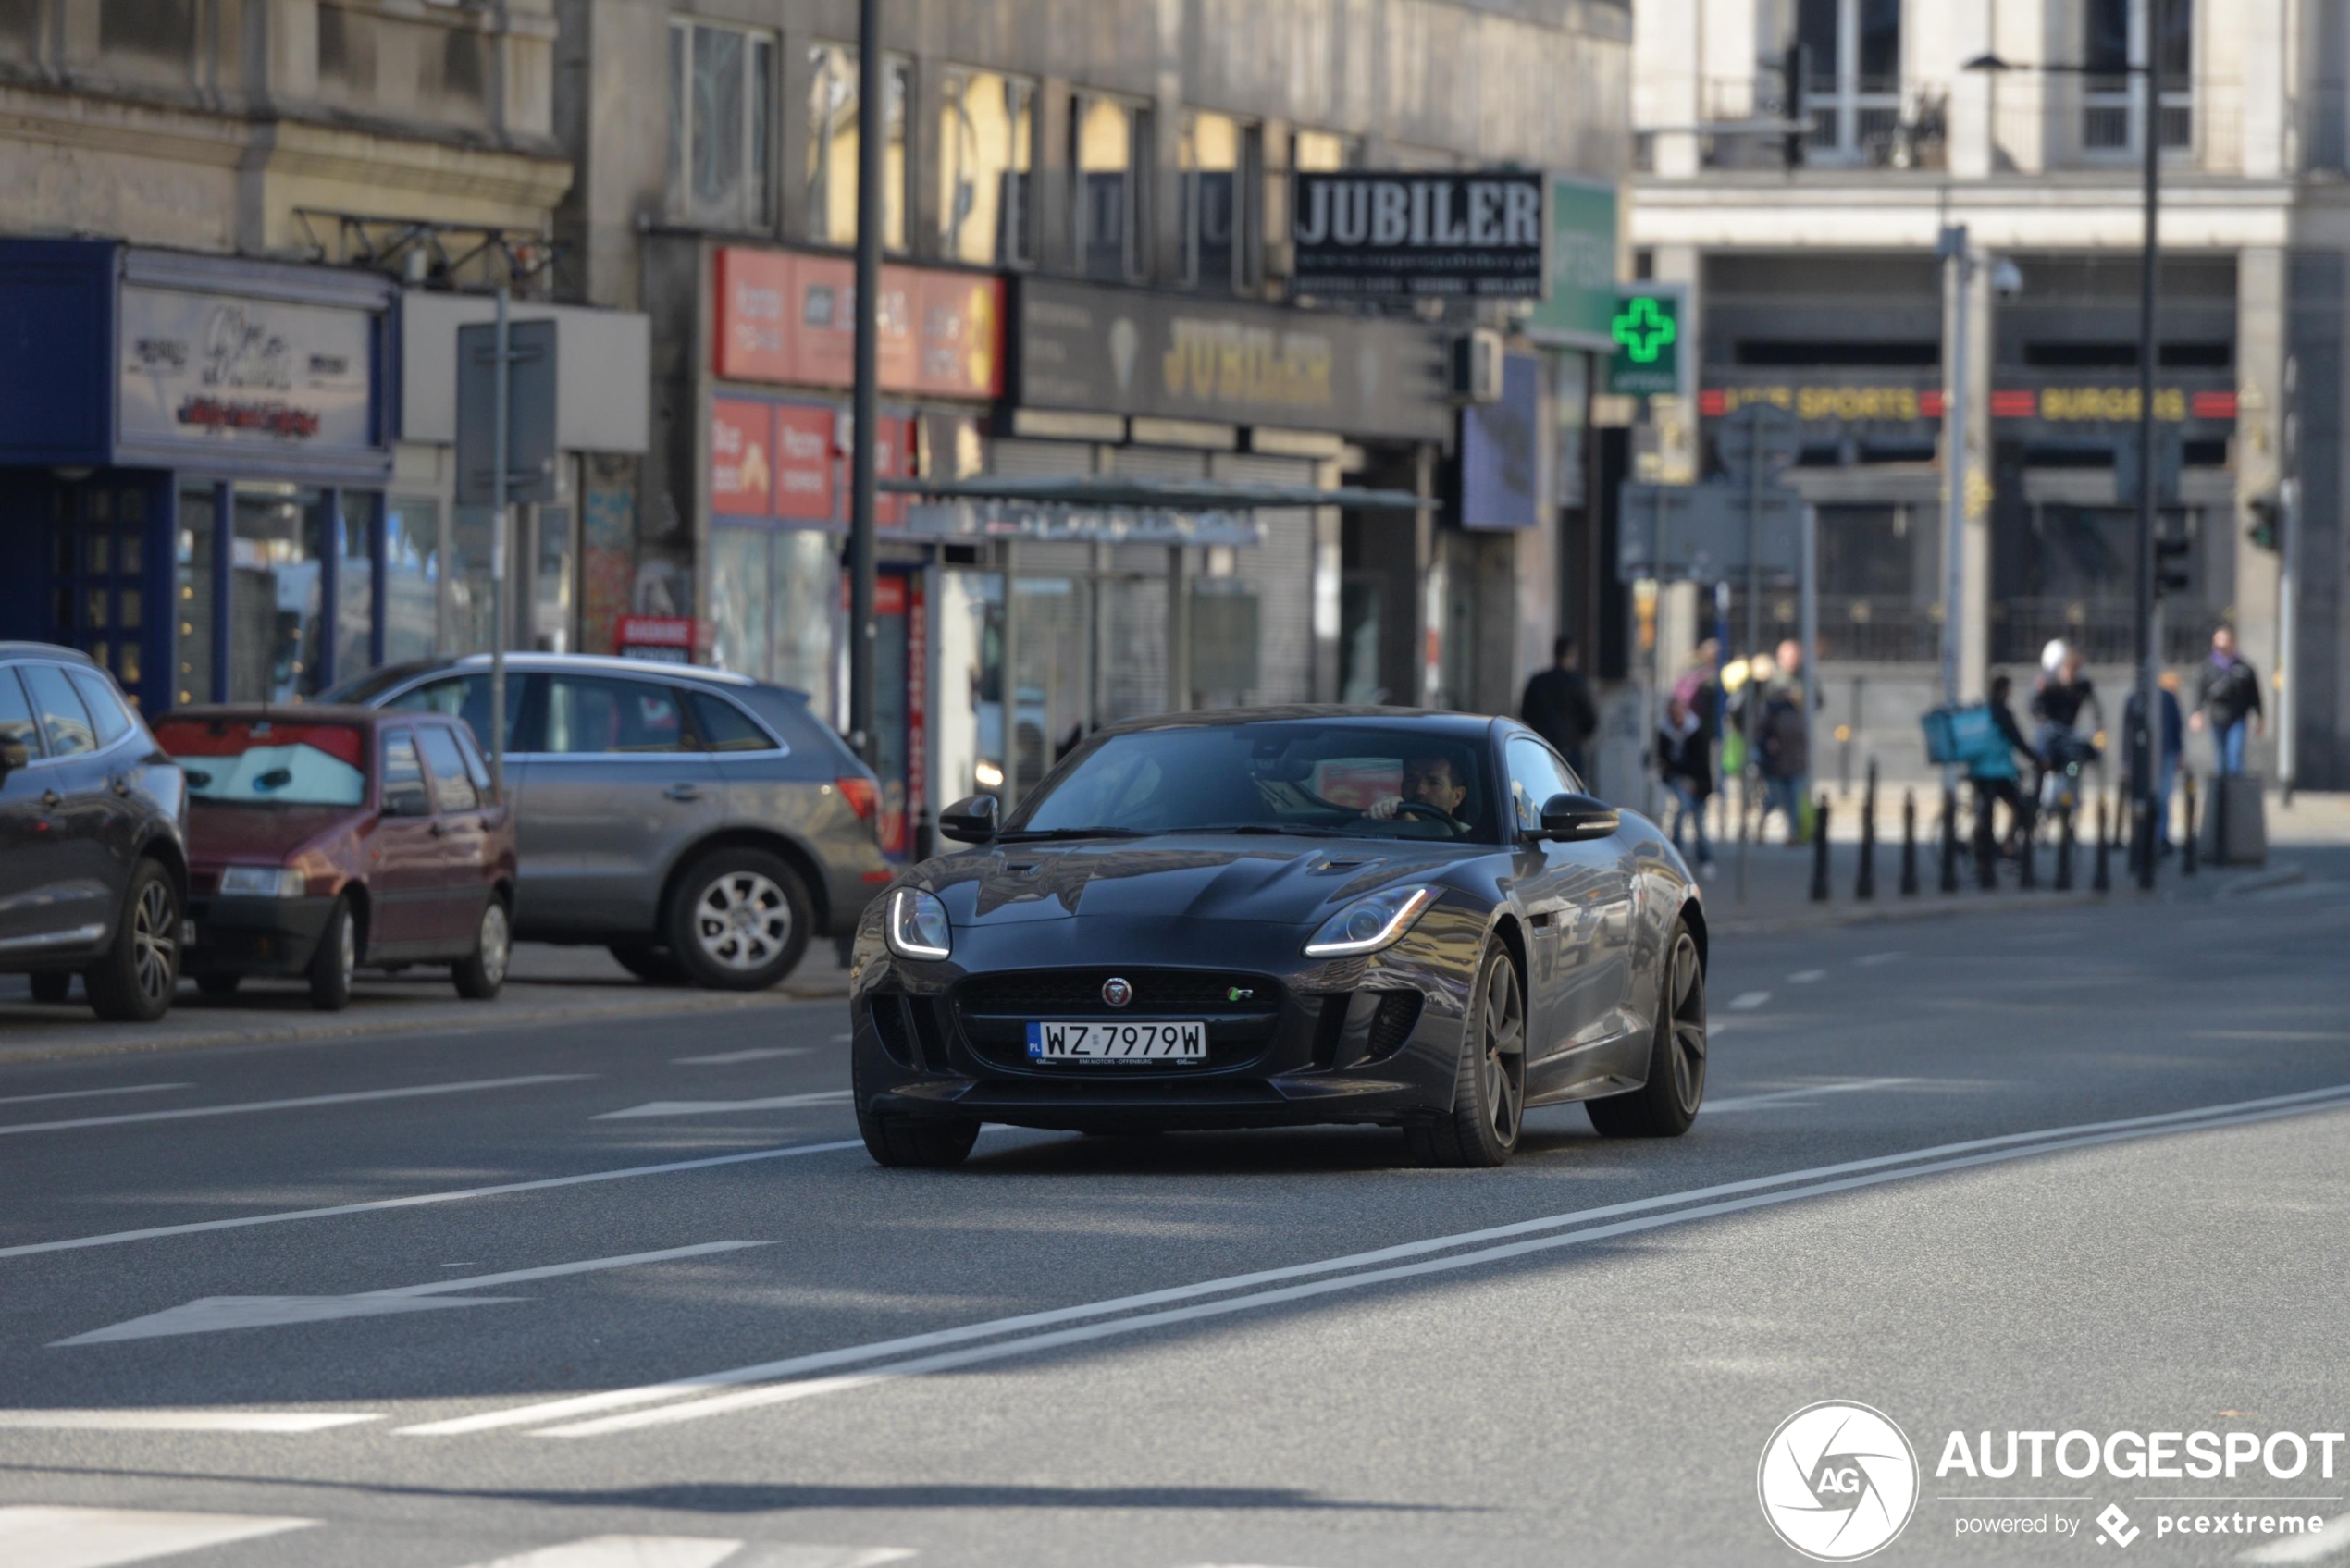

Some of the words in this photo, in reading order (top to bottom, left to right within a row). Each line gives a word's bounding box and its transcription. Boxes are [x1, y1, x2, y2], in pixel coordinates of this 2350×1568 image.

[1298, 180, 1540, 246] JUBILER
[1163, 318, 1332, 403] JUBILER
[1798, 387, 1916, 419] SPORTS
[1030, 1043, 1040, 1052] PL
[1046, 1026, 1090, 1055] WZ
[1102, 1026, 1199, 1056] 7979W
